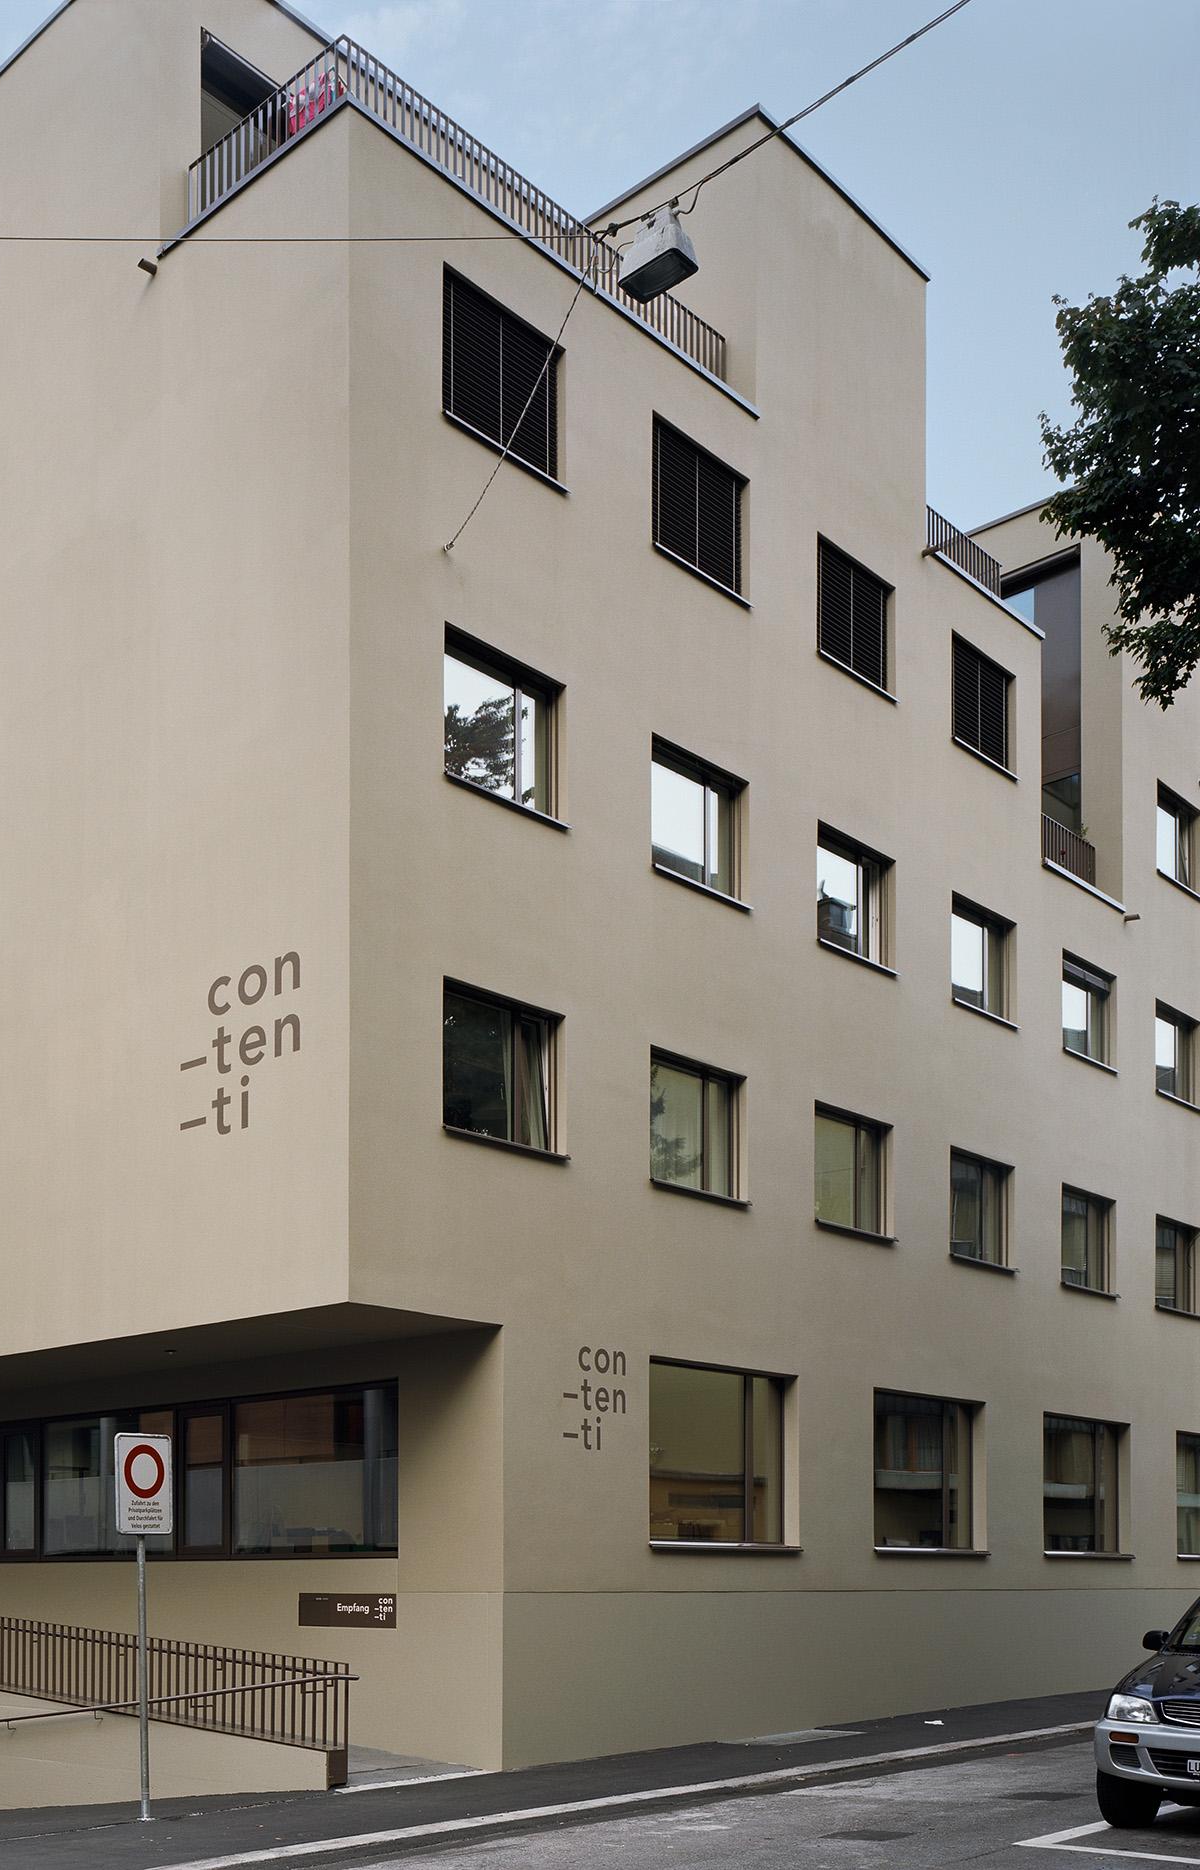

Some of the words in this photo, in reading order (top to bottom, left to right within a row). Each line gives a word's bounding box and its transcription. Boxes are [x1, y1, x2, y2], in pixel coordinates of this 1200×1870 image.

[207, 951, 301, 1016] con
[578, 1346, 626, 1377] con
[336, 1603, 370, 1615] Empfang
[378, 1597, 393, 1605] con
